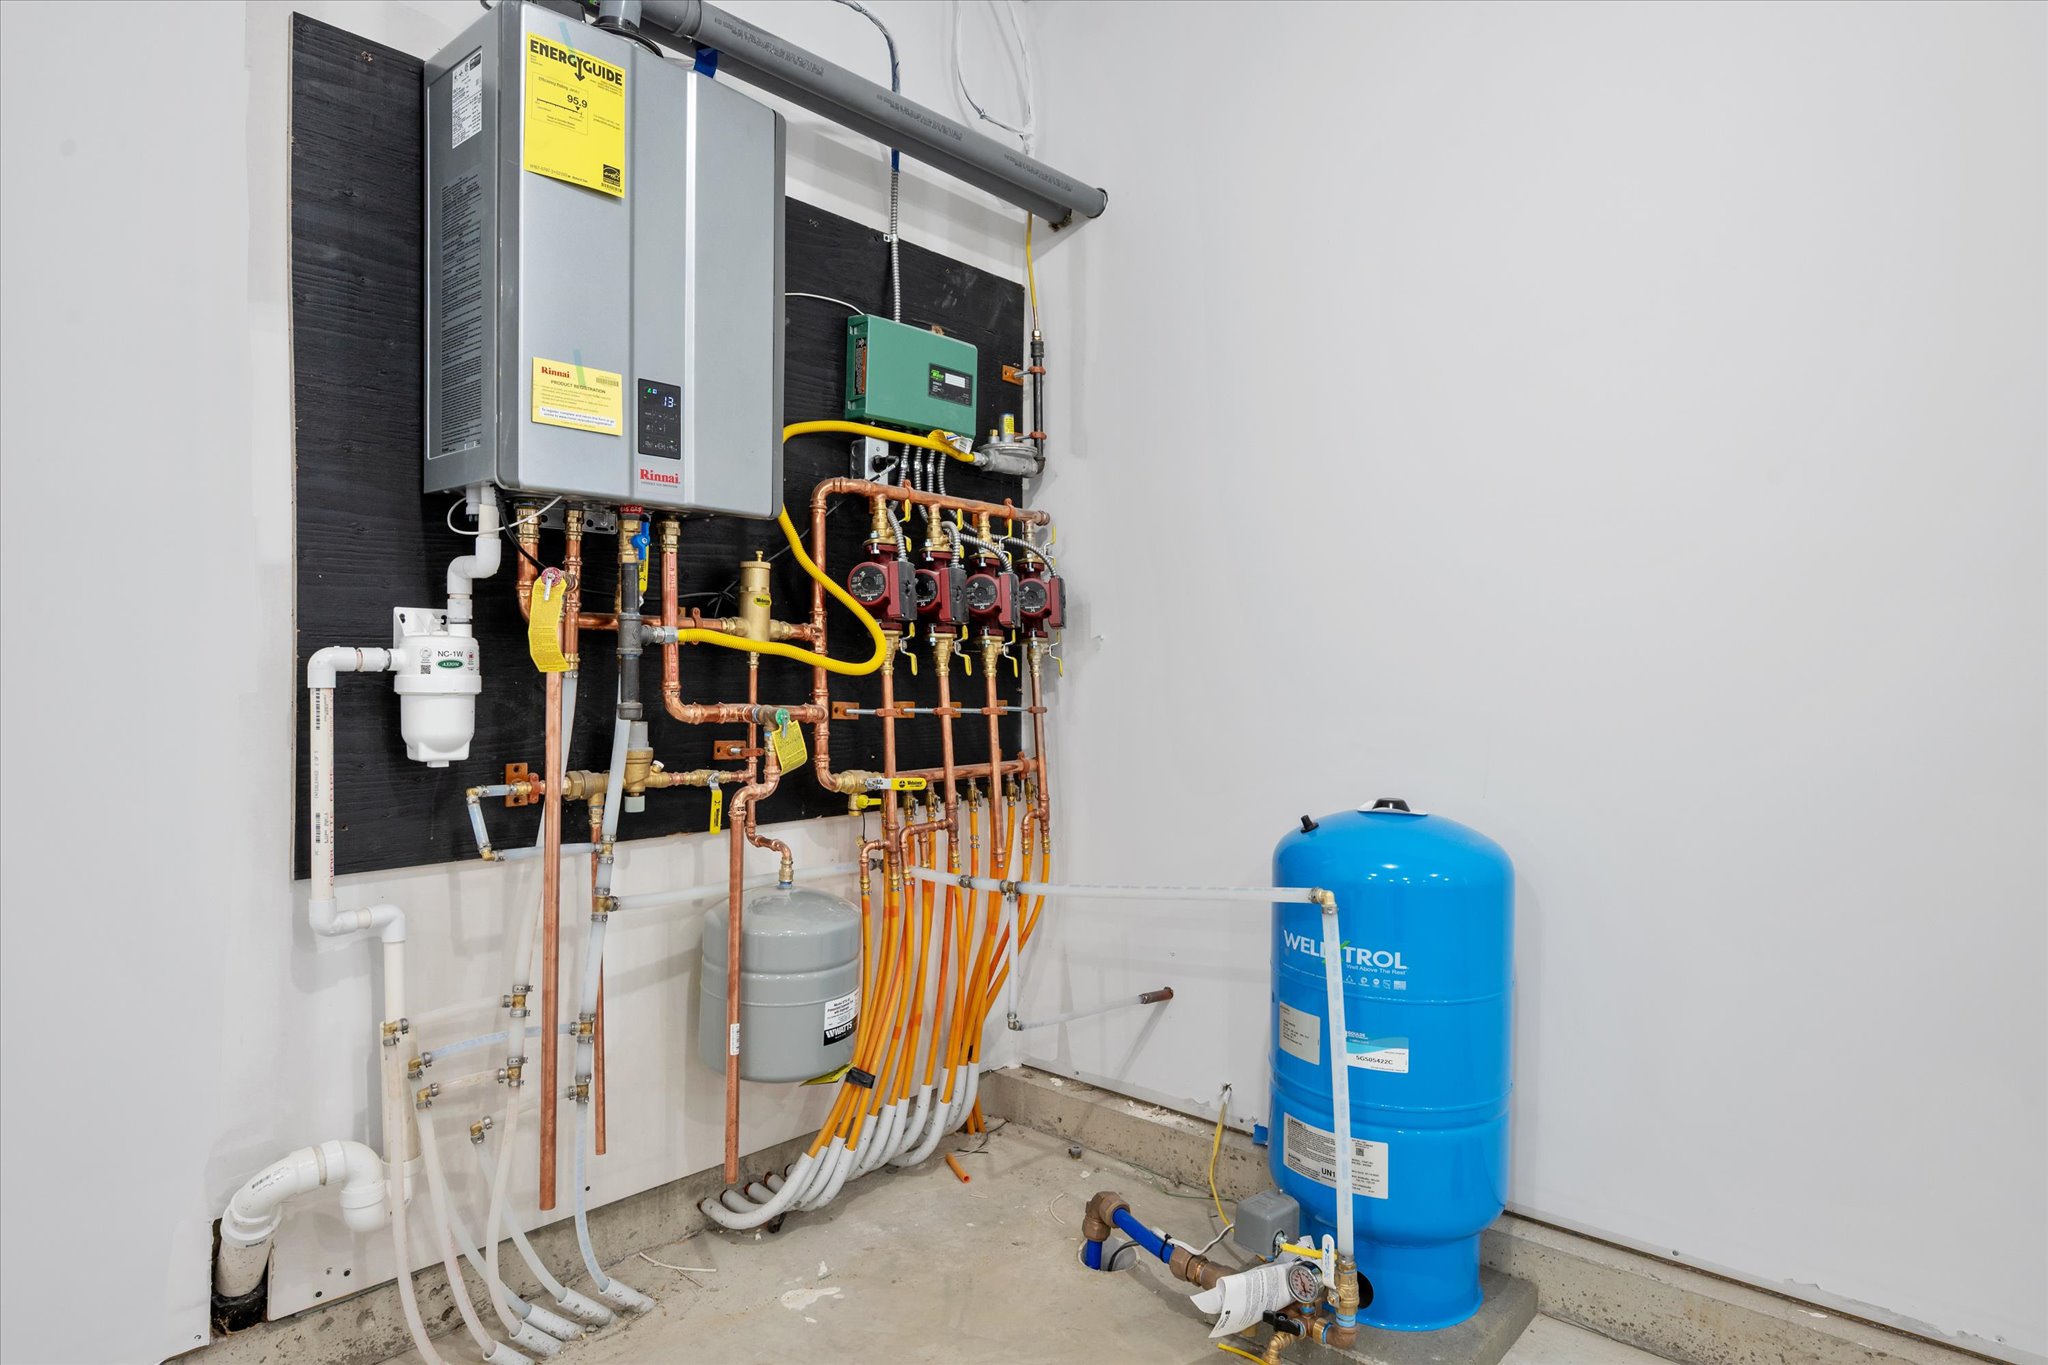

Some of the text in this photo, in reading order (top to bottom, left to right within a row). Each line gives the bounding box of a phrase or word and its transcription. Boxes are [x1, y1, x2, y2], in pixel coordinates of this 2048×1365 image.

[567, 94, 588, 108] 95.9
[541, 366, 570, 379] Rinnai
[550, 380, 606, 394] PRODUCT REGISTRATION
[640, 468, 679, 484] Rinnai
[437, 650, 464, 658] NC-1W
[1283, 929, 1408, 970] WELLTROL
